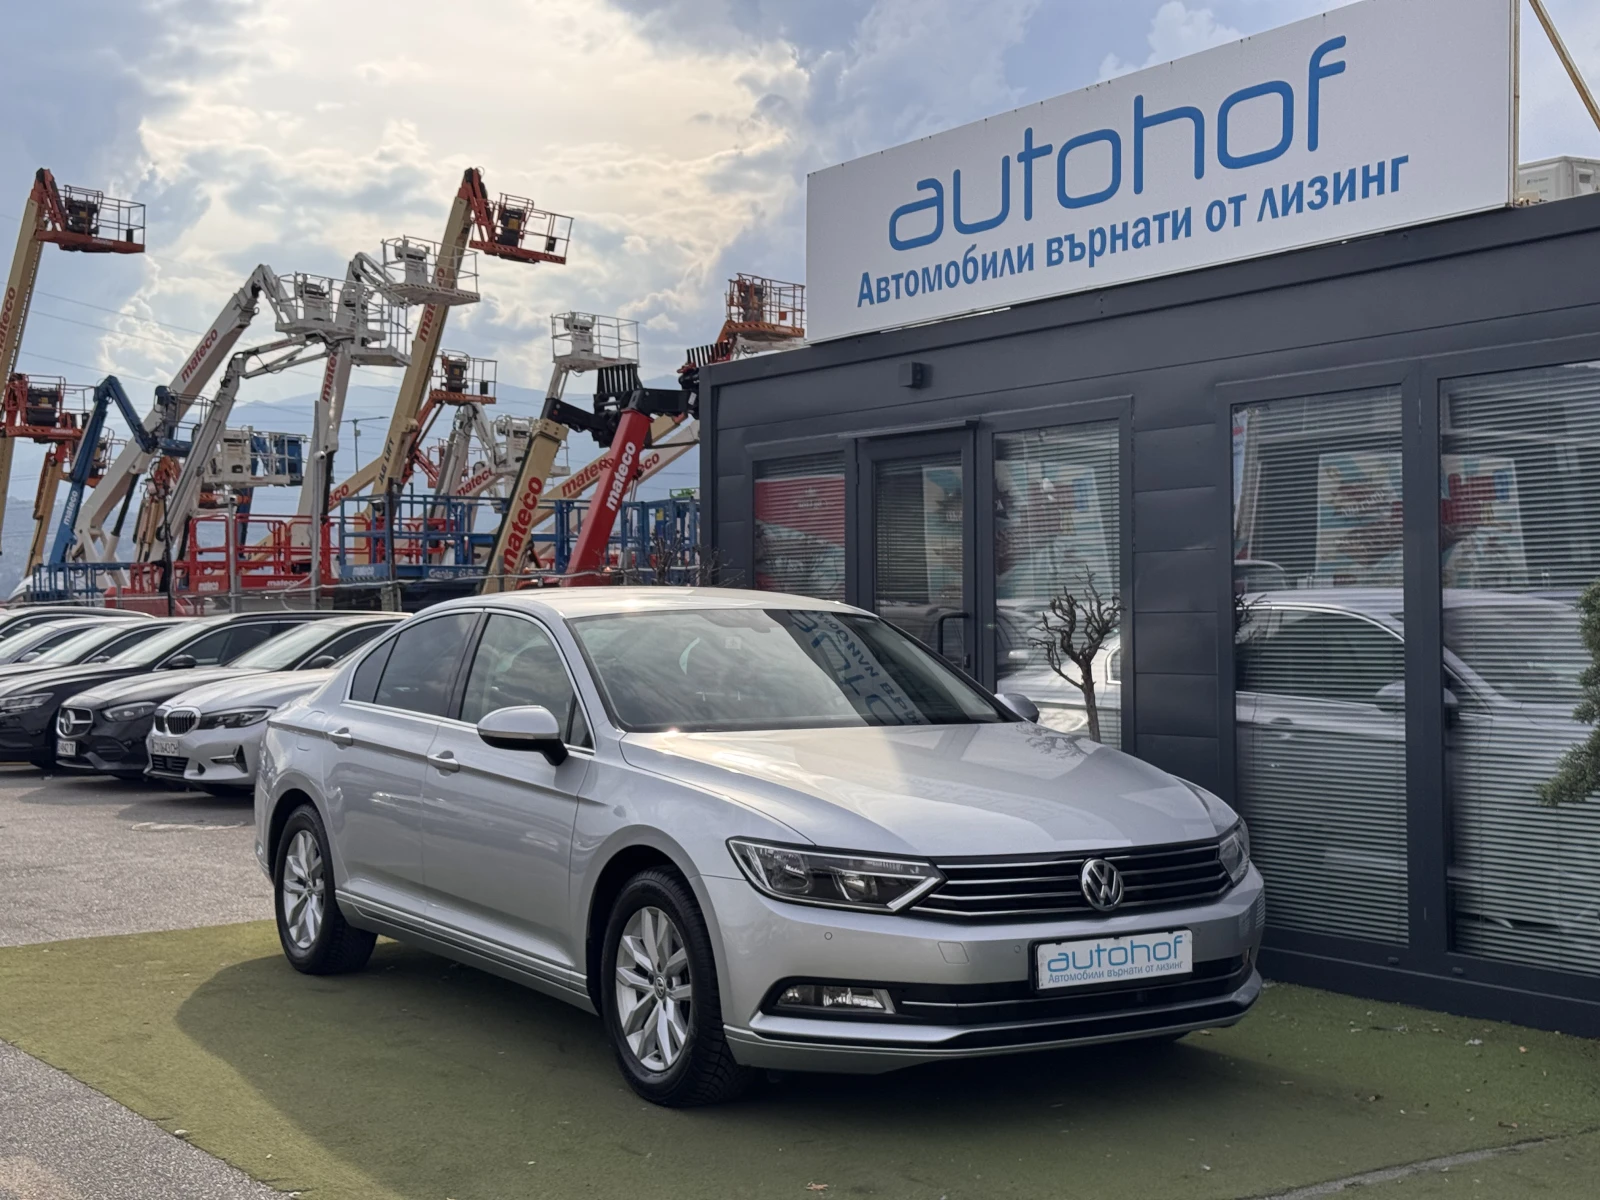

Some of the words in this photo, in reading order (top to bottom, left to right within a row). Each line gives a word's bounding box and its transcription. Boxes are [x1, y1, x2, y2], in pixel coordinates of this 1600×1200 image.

[888, 35, 1347, 251] autohof
[857, 241, 1034, 307] Автомобили
[1045, 206, 1193, 268] върнати
[1205, 193, 1248, 233] от
[1256, 154, 1410, 223] лизинг
[181, 328, 218, 383] mateco
[384, 437, 395, 463] LIFT
[605, 441, 637, 511] mateco
[63, 490, 79, 525] mateco
[1047, 935, 1183, 973] autohof
[1048, 969, 1105, 984] Автомобили
[1107, 966, 1144, 977] върнати
[1145, 963, 1155, 973] от
[1155, 960, 1184, 972] лизинг
